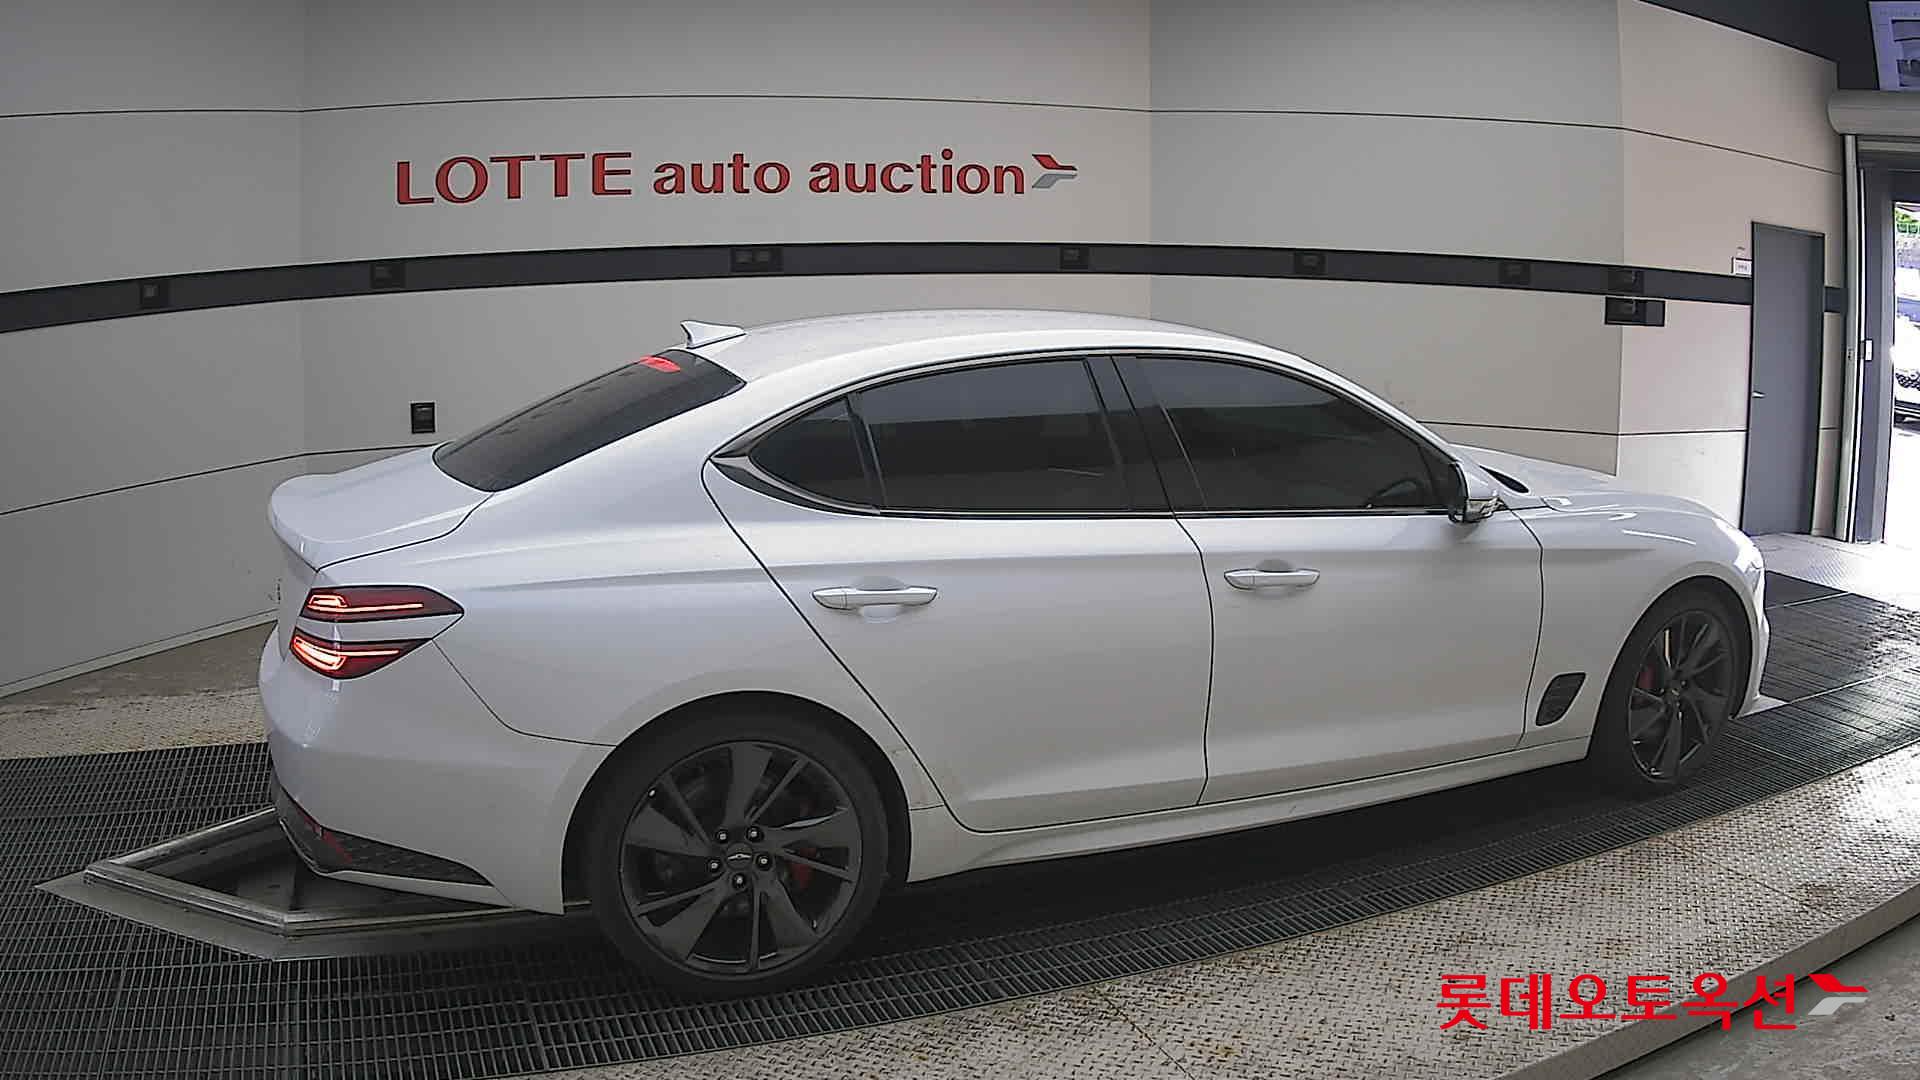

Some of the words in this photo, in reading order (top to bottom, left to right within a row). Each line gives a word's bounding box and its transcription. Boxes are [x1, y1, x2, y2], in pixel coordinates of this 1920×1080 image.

[397, 152, 632, 205] LOTTE
[654, 154, 791, 194] auto
[810, 149, 1025, 194] auction
